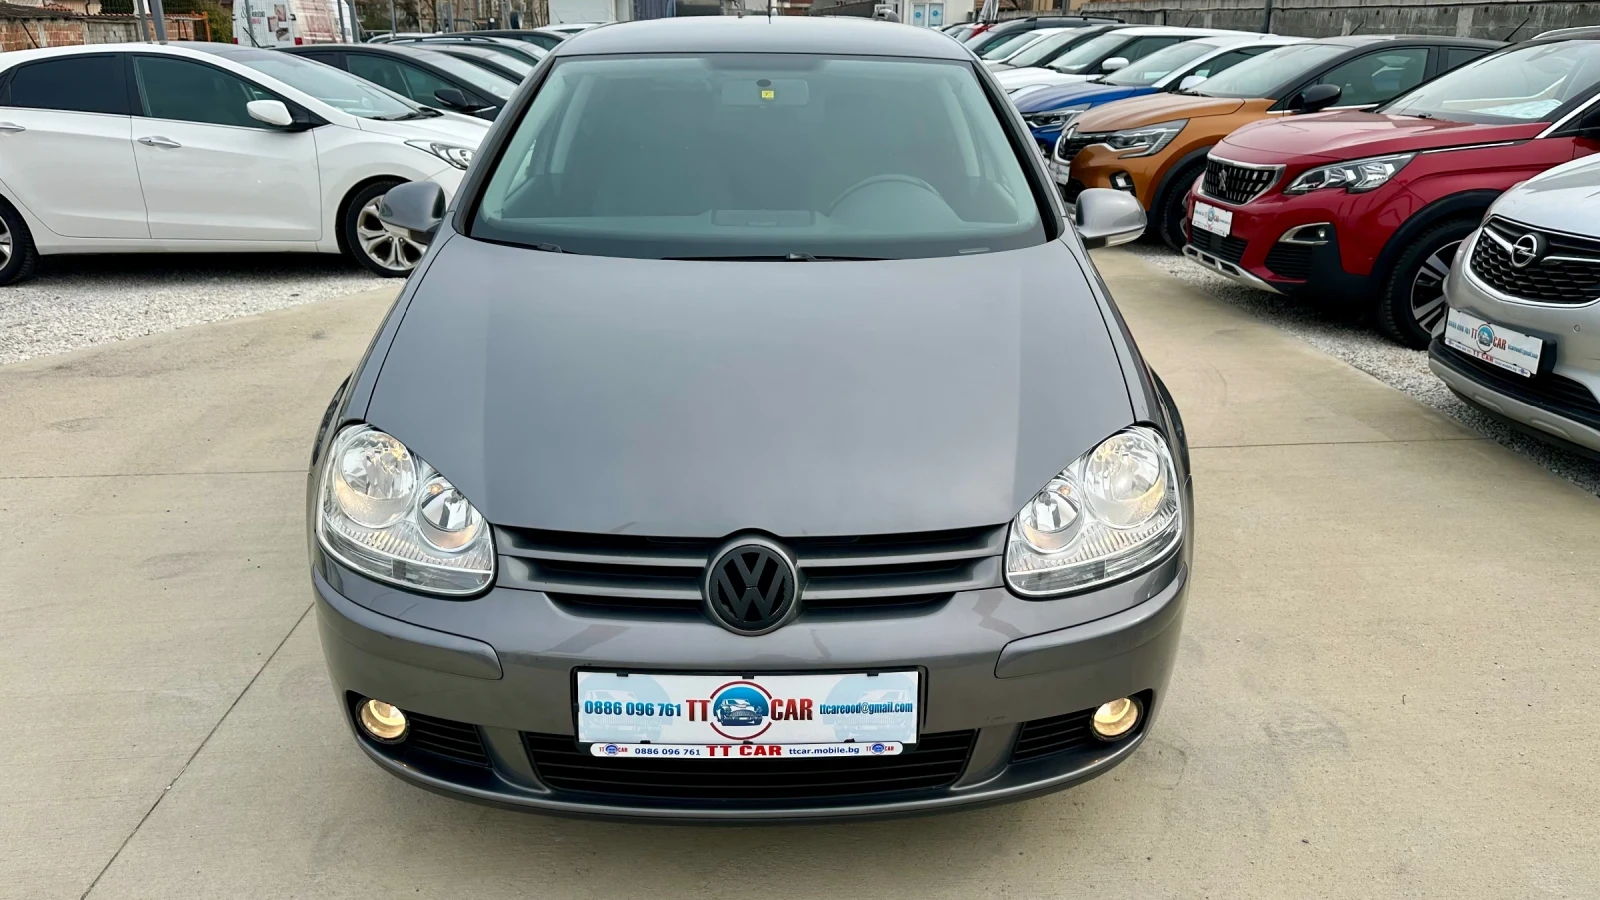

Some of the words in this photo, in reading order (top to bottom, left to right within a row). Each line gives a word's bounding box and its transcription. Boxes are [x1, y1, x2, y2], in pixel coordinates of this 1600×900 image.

[1493, 336, 1507, 350] CAR
[584, 700, 622, 716] 0886
[625, 701, 655, 717] 096
[657, 703, 681, 717] 761
[686, 699, 711, 722] TT
[770, 698, 813, 721] CAR
[819, 701, 913, 715] ttcareood@gmail.com
[634, 747, 659, 755] 0886
[683, 748, 701, 756] 761
[706, 745, 732, 757] TT
[739, 745, 782, 757] CAR
[788, 745, 860, 755] ttcar.mobile.bg
